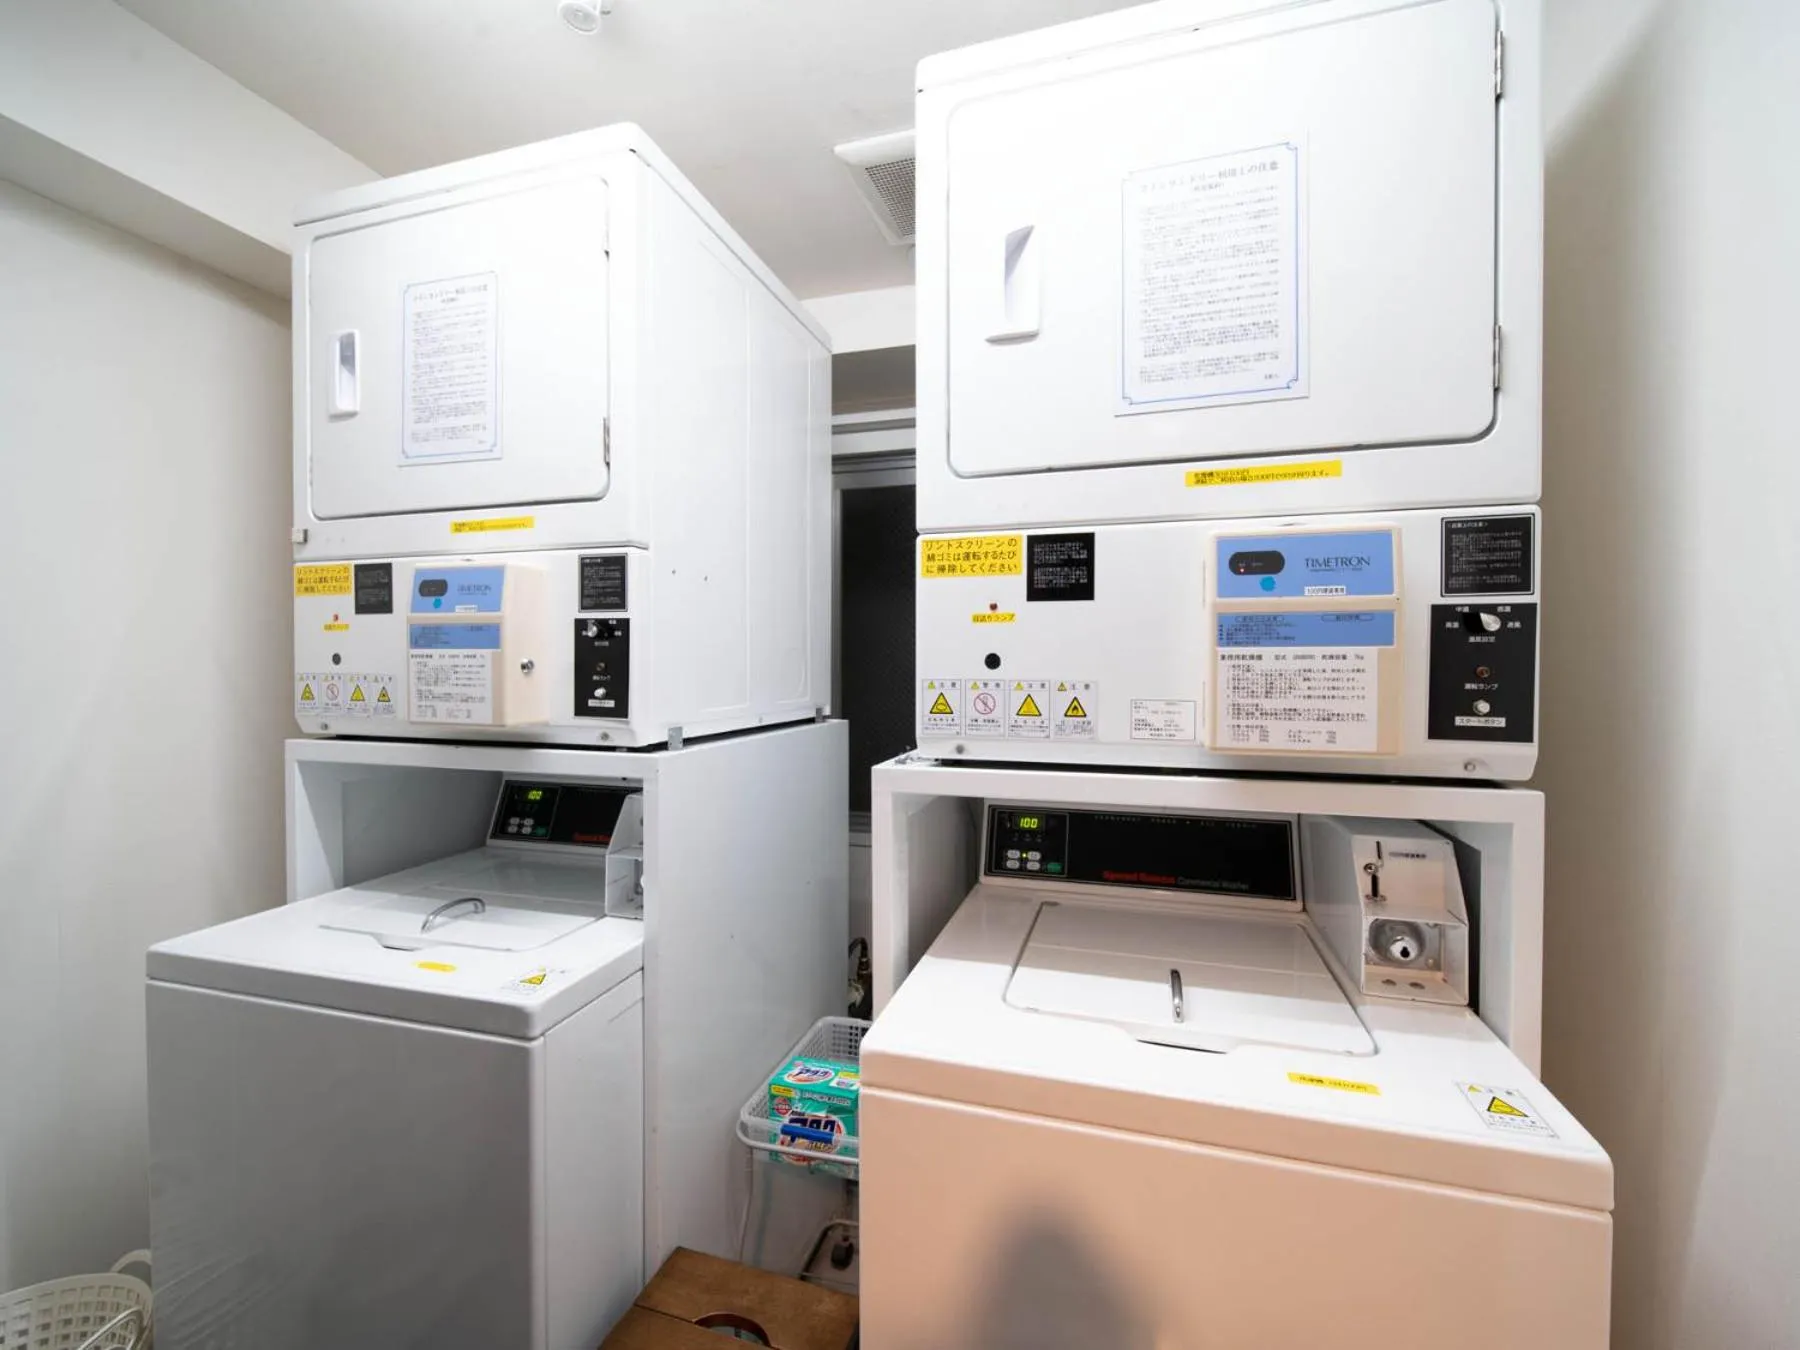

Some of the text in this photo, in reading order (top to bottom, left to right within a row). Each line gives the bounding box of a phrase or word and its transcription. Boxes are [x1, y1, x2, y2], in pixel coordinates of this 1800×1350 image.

[926, 538, 1017, 551] リントスクリーンの
[926, 551, 1017, 563] 綿ゴミは運転するたび
[1304, 555, 1371, 569] TIMETRON
[926, 563, 1017, 575] に掃除してください
[1464, 682, 1498, 690] 運転ランプ
[1459, 717, 1503, 725] スタートボタン
[1018, 816, 1038, 829] 100
